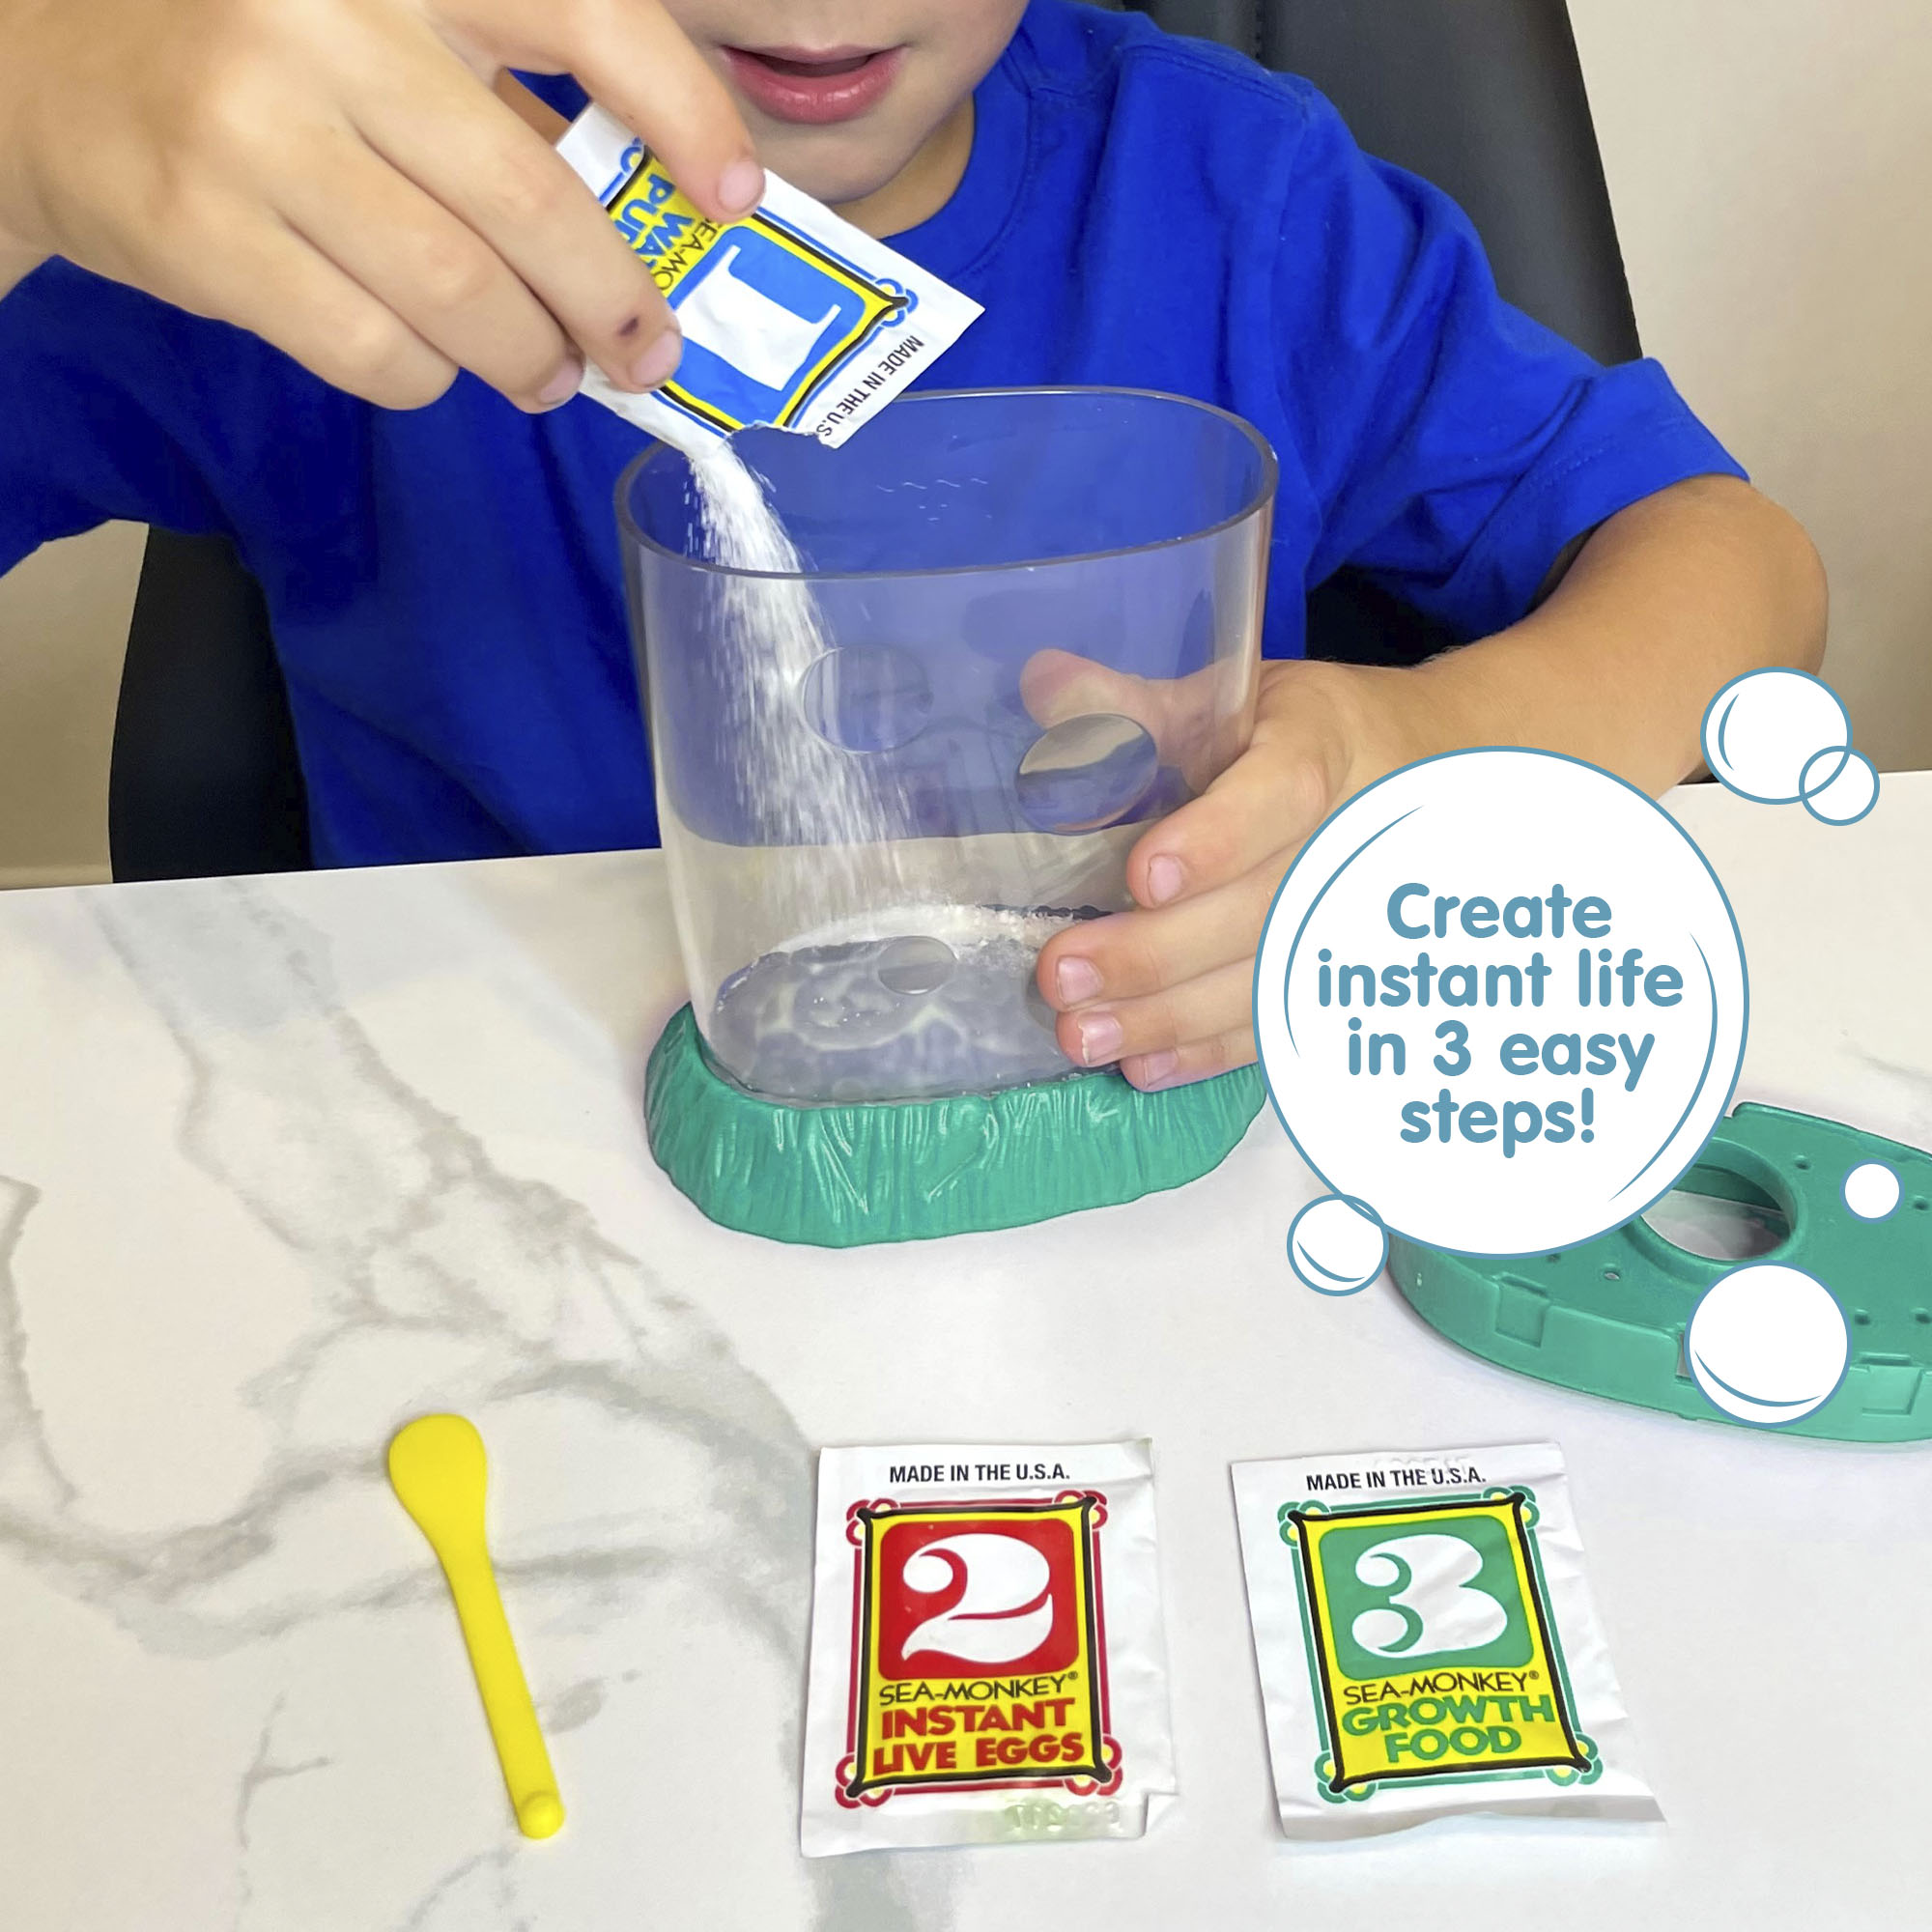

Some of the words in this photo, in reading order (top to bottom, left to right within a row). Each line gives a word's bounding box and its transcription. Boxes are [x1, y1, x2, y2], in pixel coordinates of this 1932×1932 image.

[636, 212, 693, 269] WA
[653, 218, 718, 291] EA-MO
[877, 334, 925, 376] MADE
[836, 387, 871, 415] THE
[862, 371, 886, 390] IN
[890, 1464, 945, 1483] MADE
[951, 1464, 969, 1482] IN
[975, 1463, 1010, 1481] THE
[1016, 1463, 1070, 1480] U.S.A.
[1306, 1472, 1362, 1492] MADE
[1366, 1470, 1386, 1489] IN
[1390, 1468, 1428, 1487] THE
[1431, 1466, 1487, 1485] U.S.A.
[902, 1533, 1053, 1663] 2
[1352, 1534, 1508, 1659] 3
[881, 1697, 1075, 1740] INSTANT
[1341, 1694, 1555, 1737] GROWTH
[873, 1741, 956, 1776] LIVE
[976, 1732, 1085, 1767] EGGS
[1384, 1725, 1522, 1763] FOOD
